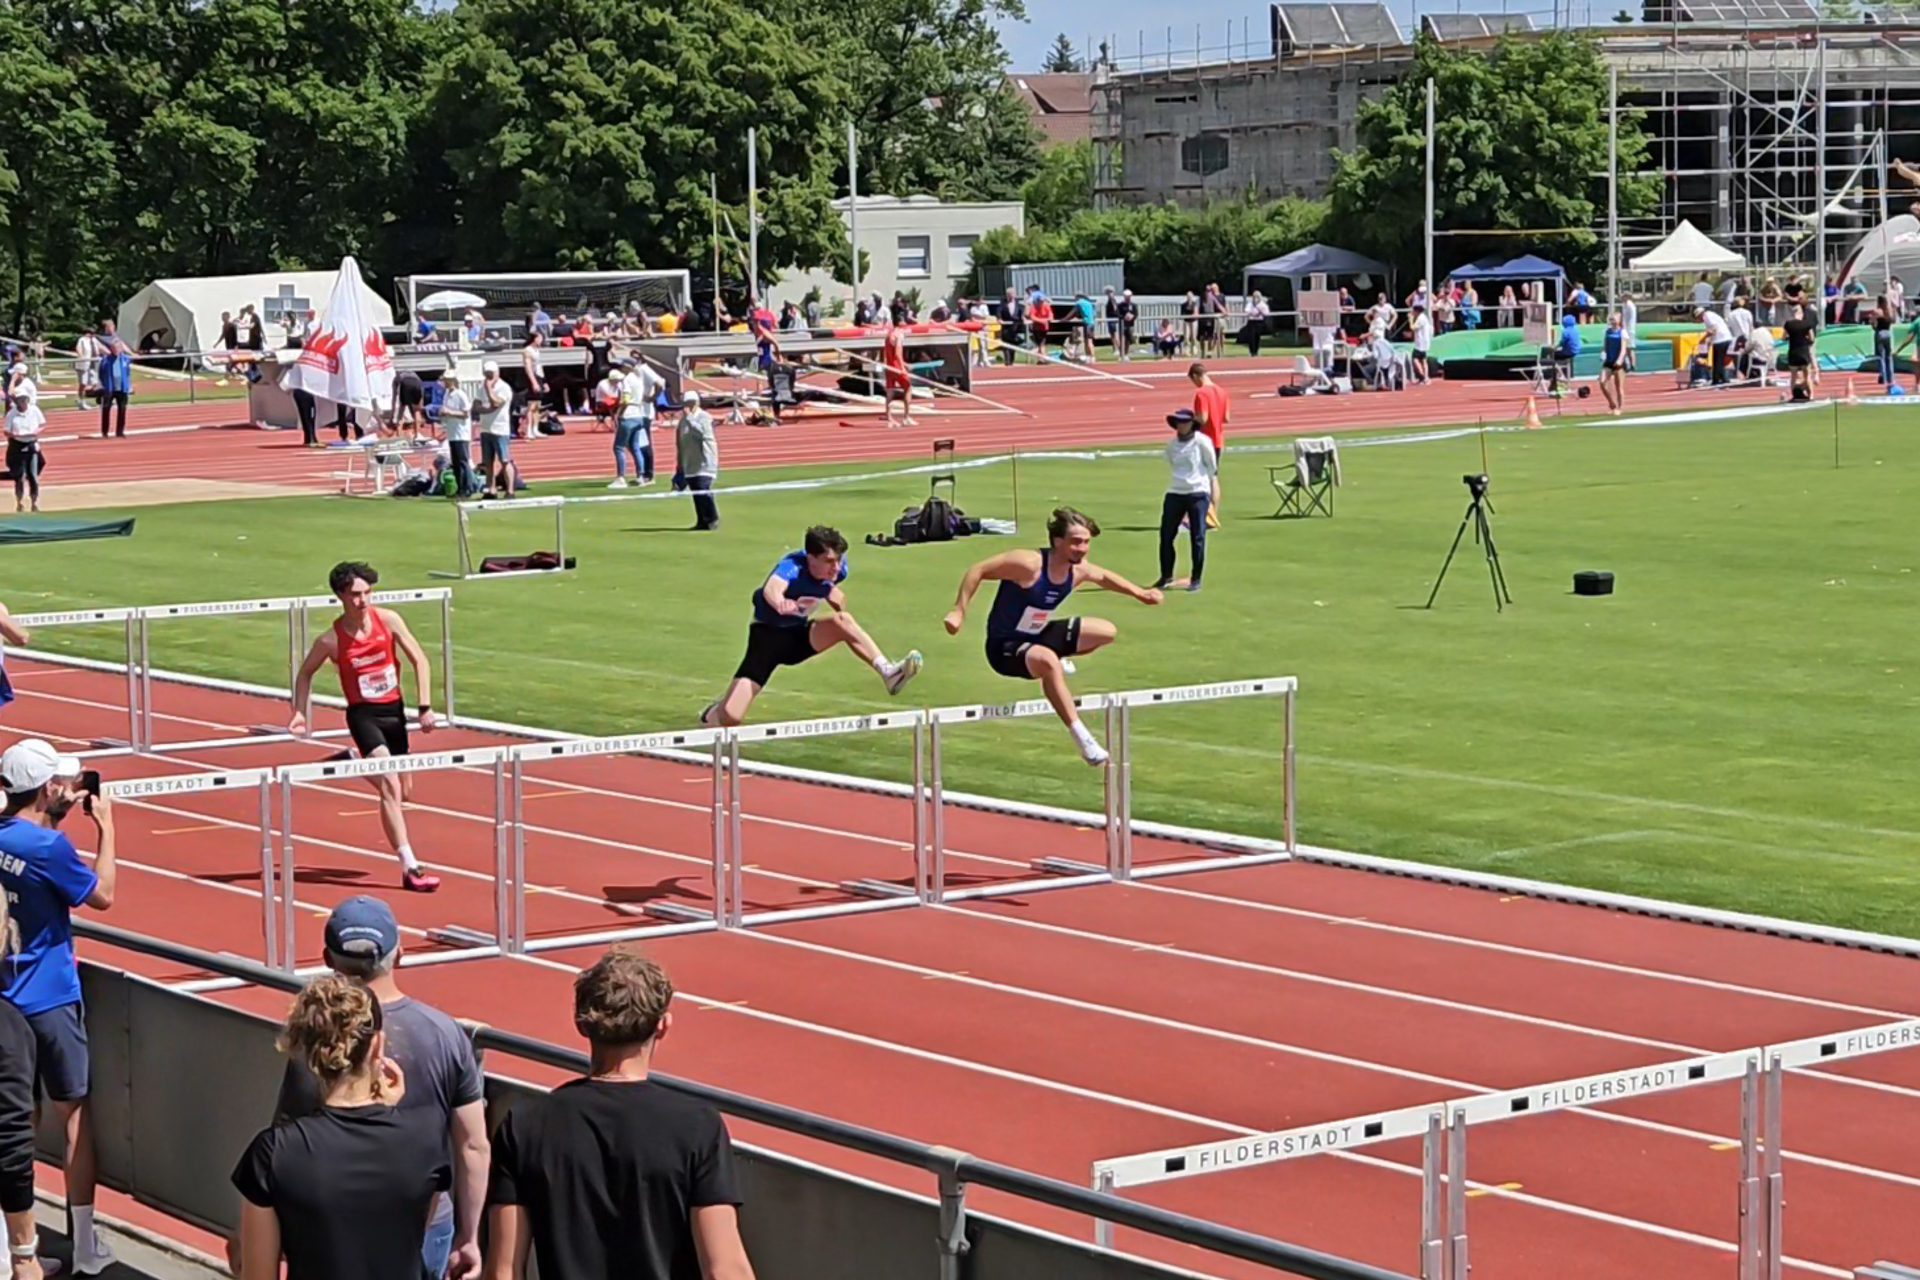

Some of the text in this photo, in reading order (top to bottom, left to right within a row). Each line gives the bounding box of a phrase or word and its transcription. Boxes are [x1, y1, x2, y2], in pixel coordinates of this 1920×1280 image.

[1169, 684, 1247, 700] FILDERSTADT
[784, 718, 871, 735] FILDERSTADT
[572, 736, 665, 753] FILDERSTADT
[344, 755, 445, 774] FILDERSTADT
[107, 778, 204, 796] ILDERSTADT
[1542, 1069, 1676, 1107] FILDERSTADT
[1200, 1126, 1352, 1167] FILDERSTADT
